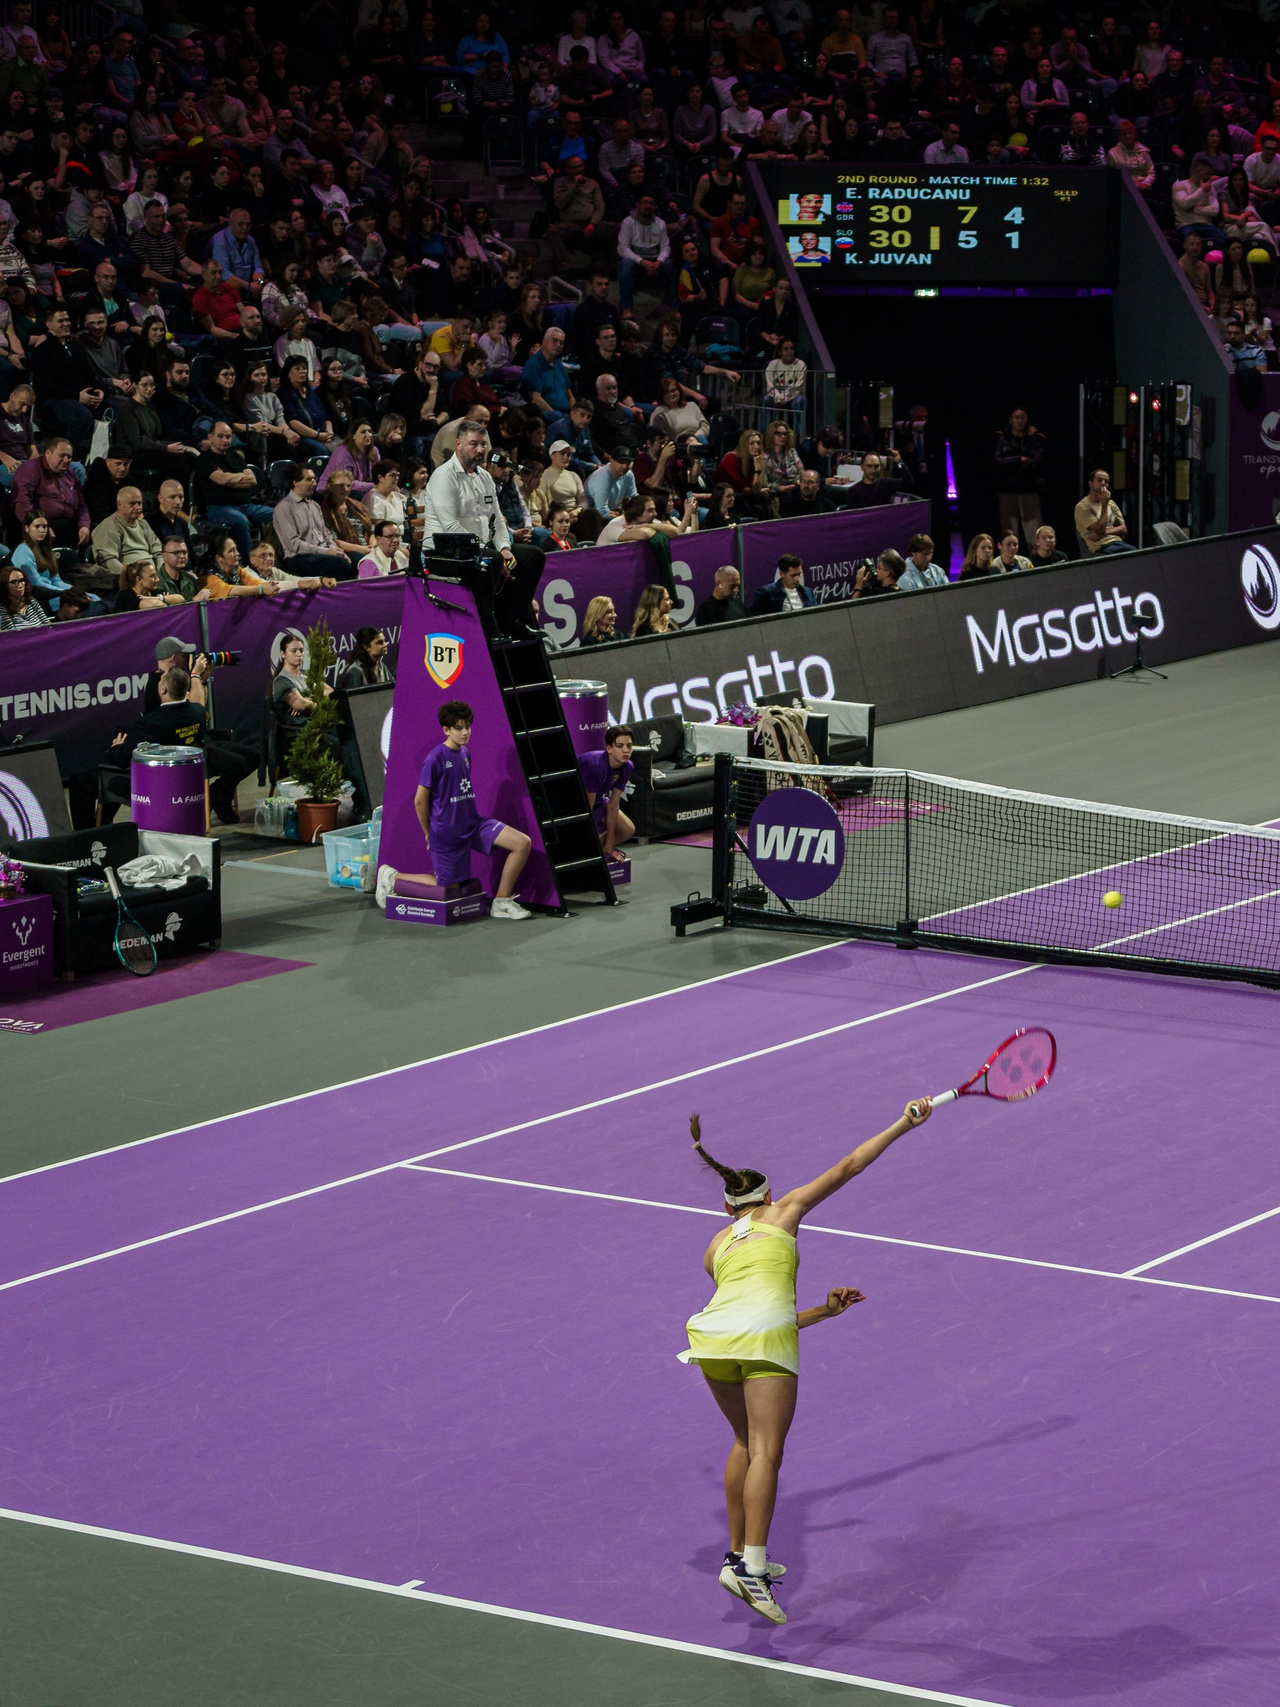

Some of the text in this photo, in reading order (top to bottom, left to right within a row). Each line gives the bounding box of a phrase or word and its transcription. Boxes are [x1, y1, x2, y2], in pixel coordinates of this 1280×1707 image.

[837, 175, 1049, 187] 2ND ROUND MATCH TIME 1:32
[846, 188, 971, 200] E. RADUCANU
[869, 205, 1025, 225] 30 7 4
[869, 229, 1020, 249] 30 5 1
[845, 253, 932, 265] K. JUVAN
[965, 587, 1165, 674] Masatto
[433, 645, 456, 663] BT
[0, 673, 149, 721] TENNIS.COM
[676, 806, 713, 822] DEDEMAN
[756, 823, 836, 866] WTA
[2, 944, 46, 964] Evergent
